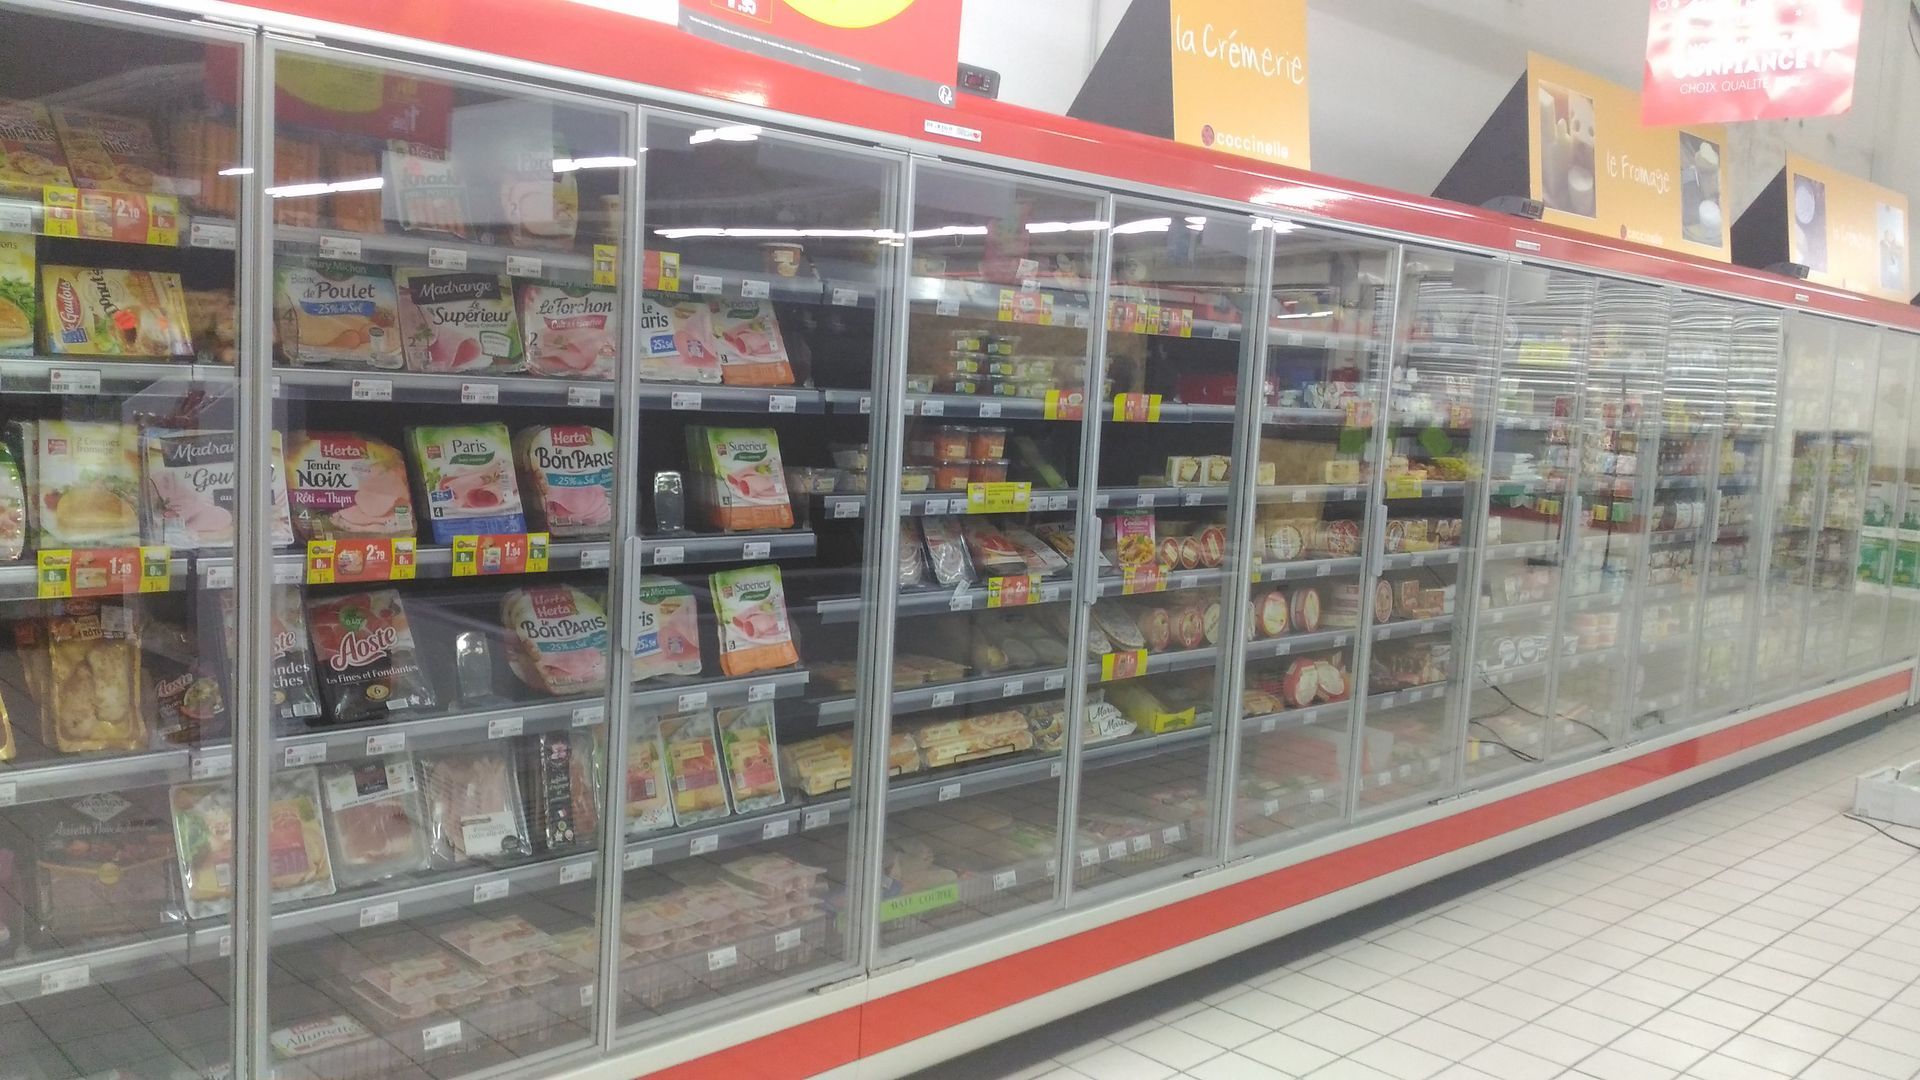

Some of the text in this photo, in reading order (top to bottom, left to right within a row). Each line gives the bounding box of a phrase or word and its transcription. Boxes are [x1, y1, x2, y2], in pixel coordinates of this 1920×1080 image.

[1175, 14, 1305, 85] la Crémerie
[1679, 82, 1716, 95] CHOIX
[1216, 132, 1290, 161] coccinelle
[1606, 148, 1672, 195] le Fromage
[315, 282, 376, 299] Poulet
[420, 279, 493, 300] Madrange
[60, 280, 79, 323] Gaulois
[536, 297, 614, 315] Le Torchon
[642, 302, 653, 314] Le
[432, 307, 511, 327] Supérieur
[641, 312, 669, 329] aris
[452, 438, 487, 454] Paris
[552, 431, 587, 445] Herta
[729, 440, 767, 453] Supérieur
[173, 441, 234, 462] Madra
[323, 443, 361, 457] Herta
[304, 459, 341, 471] Tendre
[295, 491, 316, 504] Rôti
[326, 492, 353, 508] Thym
[298, 509, 311, 520] 4
[650, 586, 676, 597] Michon
[735, 579, 771, 592] Supérieur
[536, 605, 571, 618] Herta
[330, 626, 397, 671] Aoste
[273, 675, 304, 689] ches
[338, 674, 362, 684] Fines
[362, 671, 372, 680] et
[373, 663, 419, 679] Fondantes
